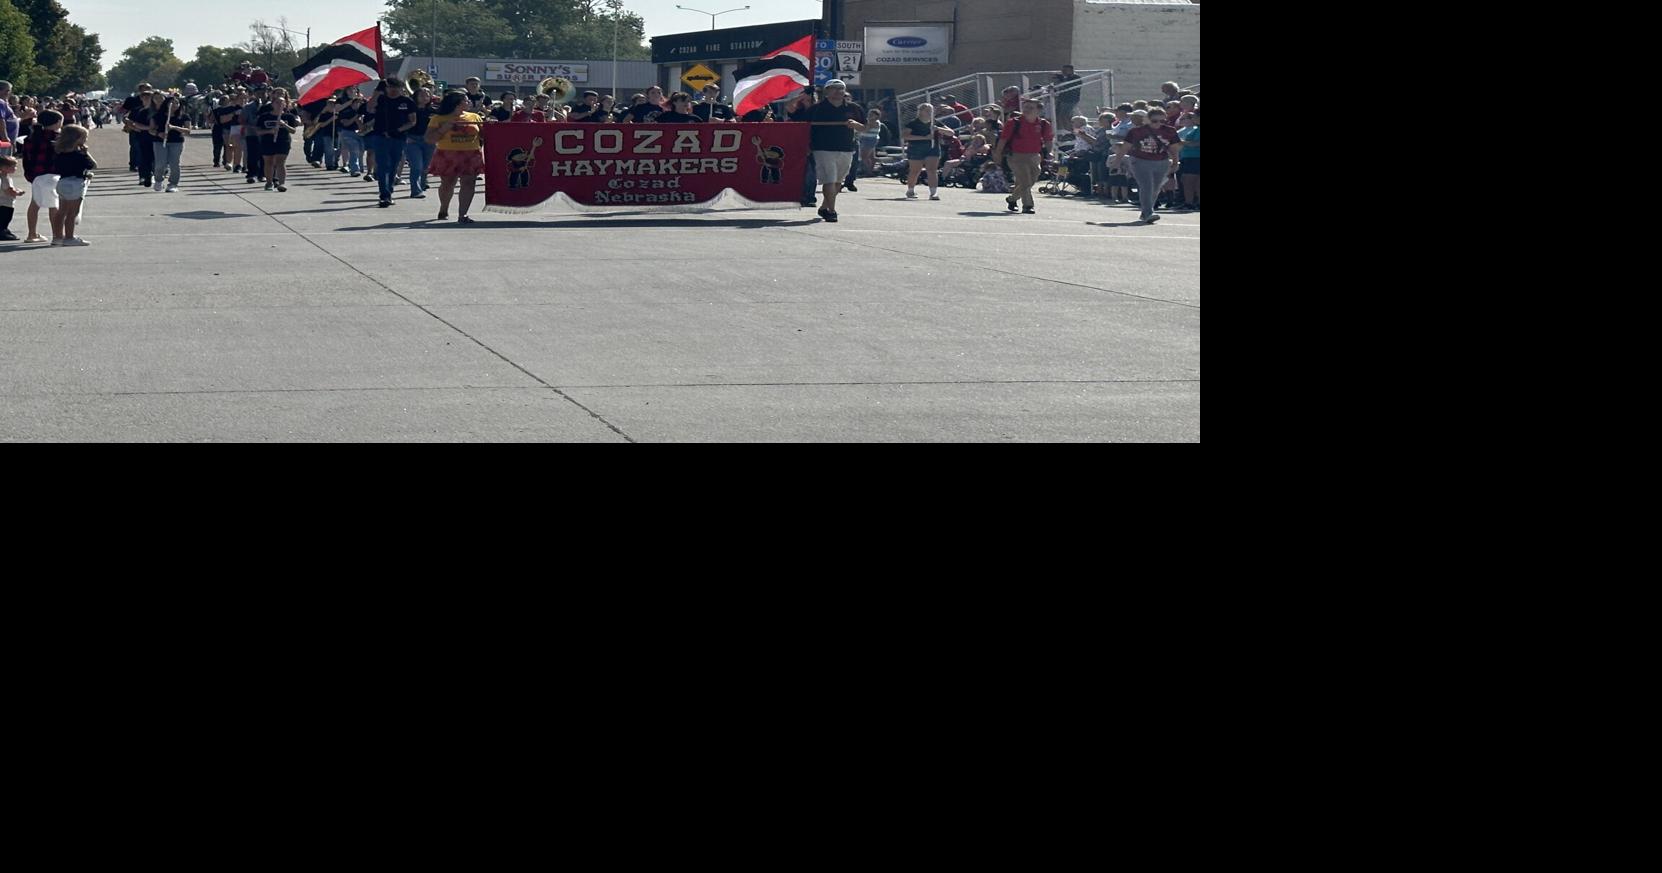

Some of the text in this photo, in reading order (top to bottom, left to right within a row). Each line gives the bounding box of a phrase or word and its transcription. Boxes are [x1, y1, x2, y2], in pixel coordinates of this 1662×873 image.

[705, 43, 720, 52] FIRE
[843, 55, 856, 65] 21
[504, 63, 571, 74] SONNY'S
[554, 129, 743, 154] COZAD
[551, 157, 738, 177] HAYMAKERS
[608, 176, 681, 189] Cozad
[594, 190, 696, 203] Nebraska
